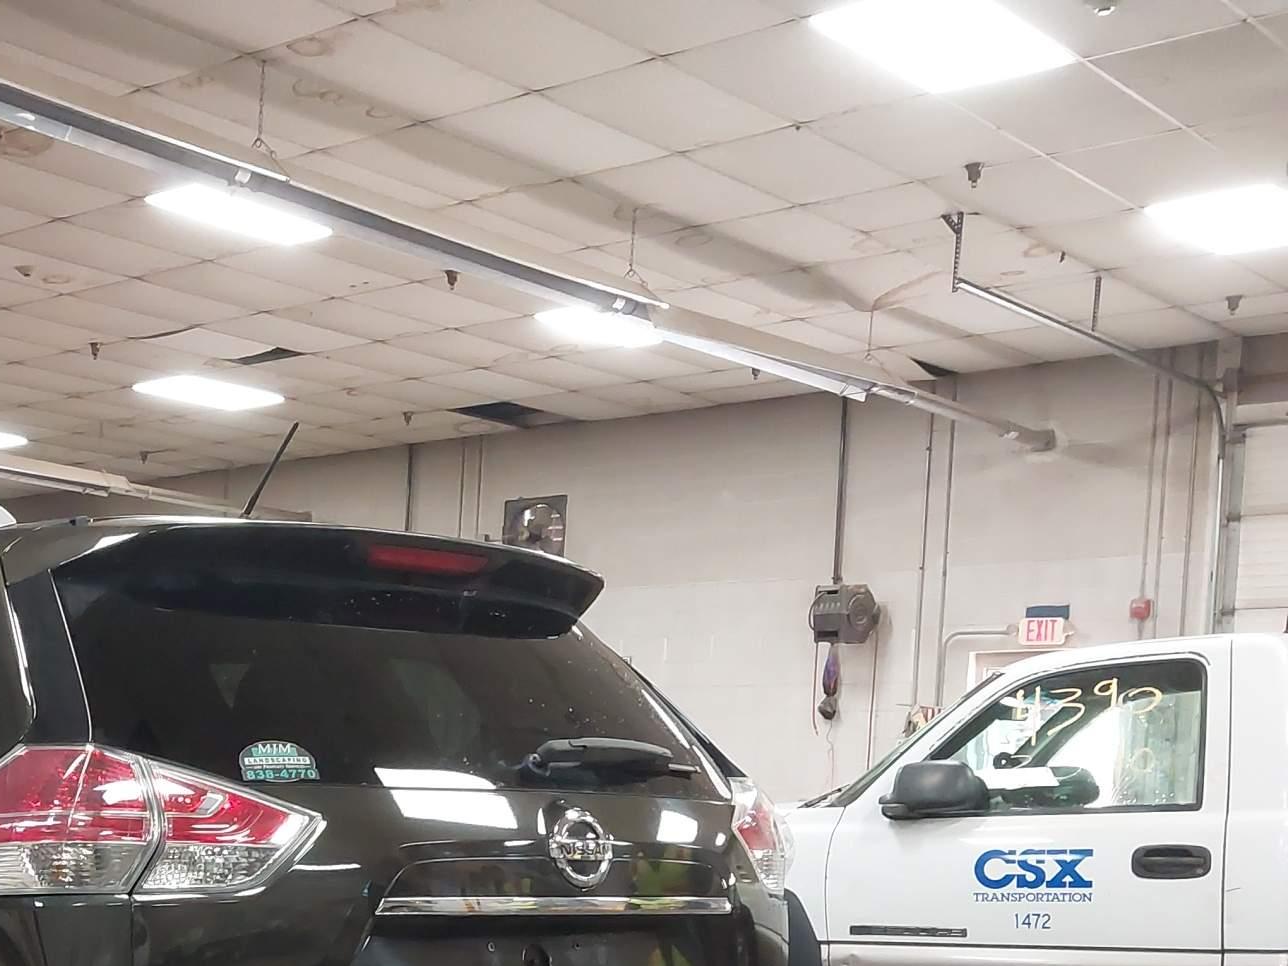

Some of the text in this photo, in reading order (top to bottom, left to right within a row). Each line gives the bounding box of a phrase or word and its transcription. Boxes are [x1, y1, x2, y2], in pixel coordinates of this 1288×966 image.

[1027, 620, 1057, 641] EXIT
[1016, 678, 1163, 746] 4390
[258, 743, 291, 755] MJM
[974, 849, 1094, 889] CSX
[973, 892, 1093, 903] TRANSPORTATION
[1015, 913, 1052, 929] 1472
